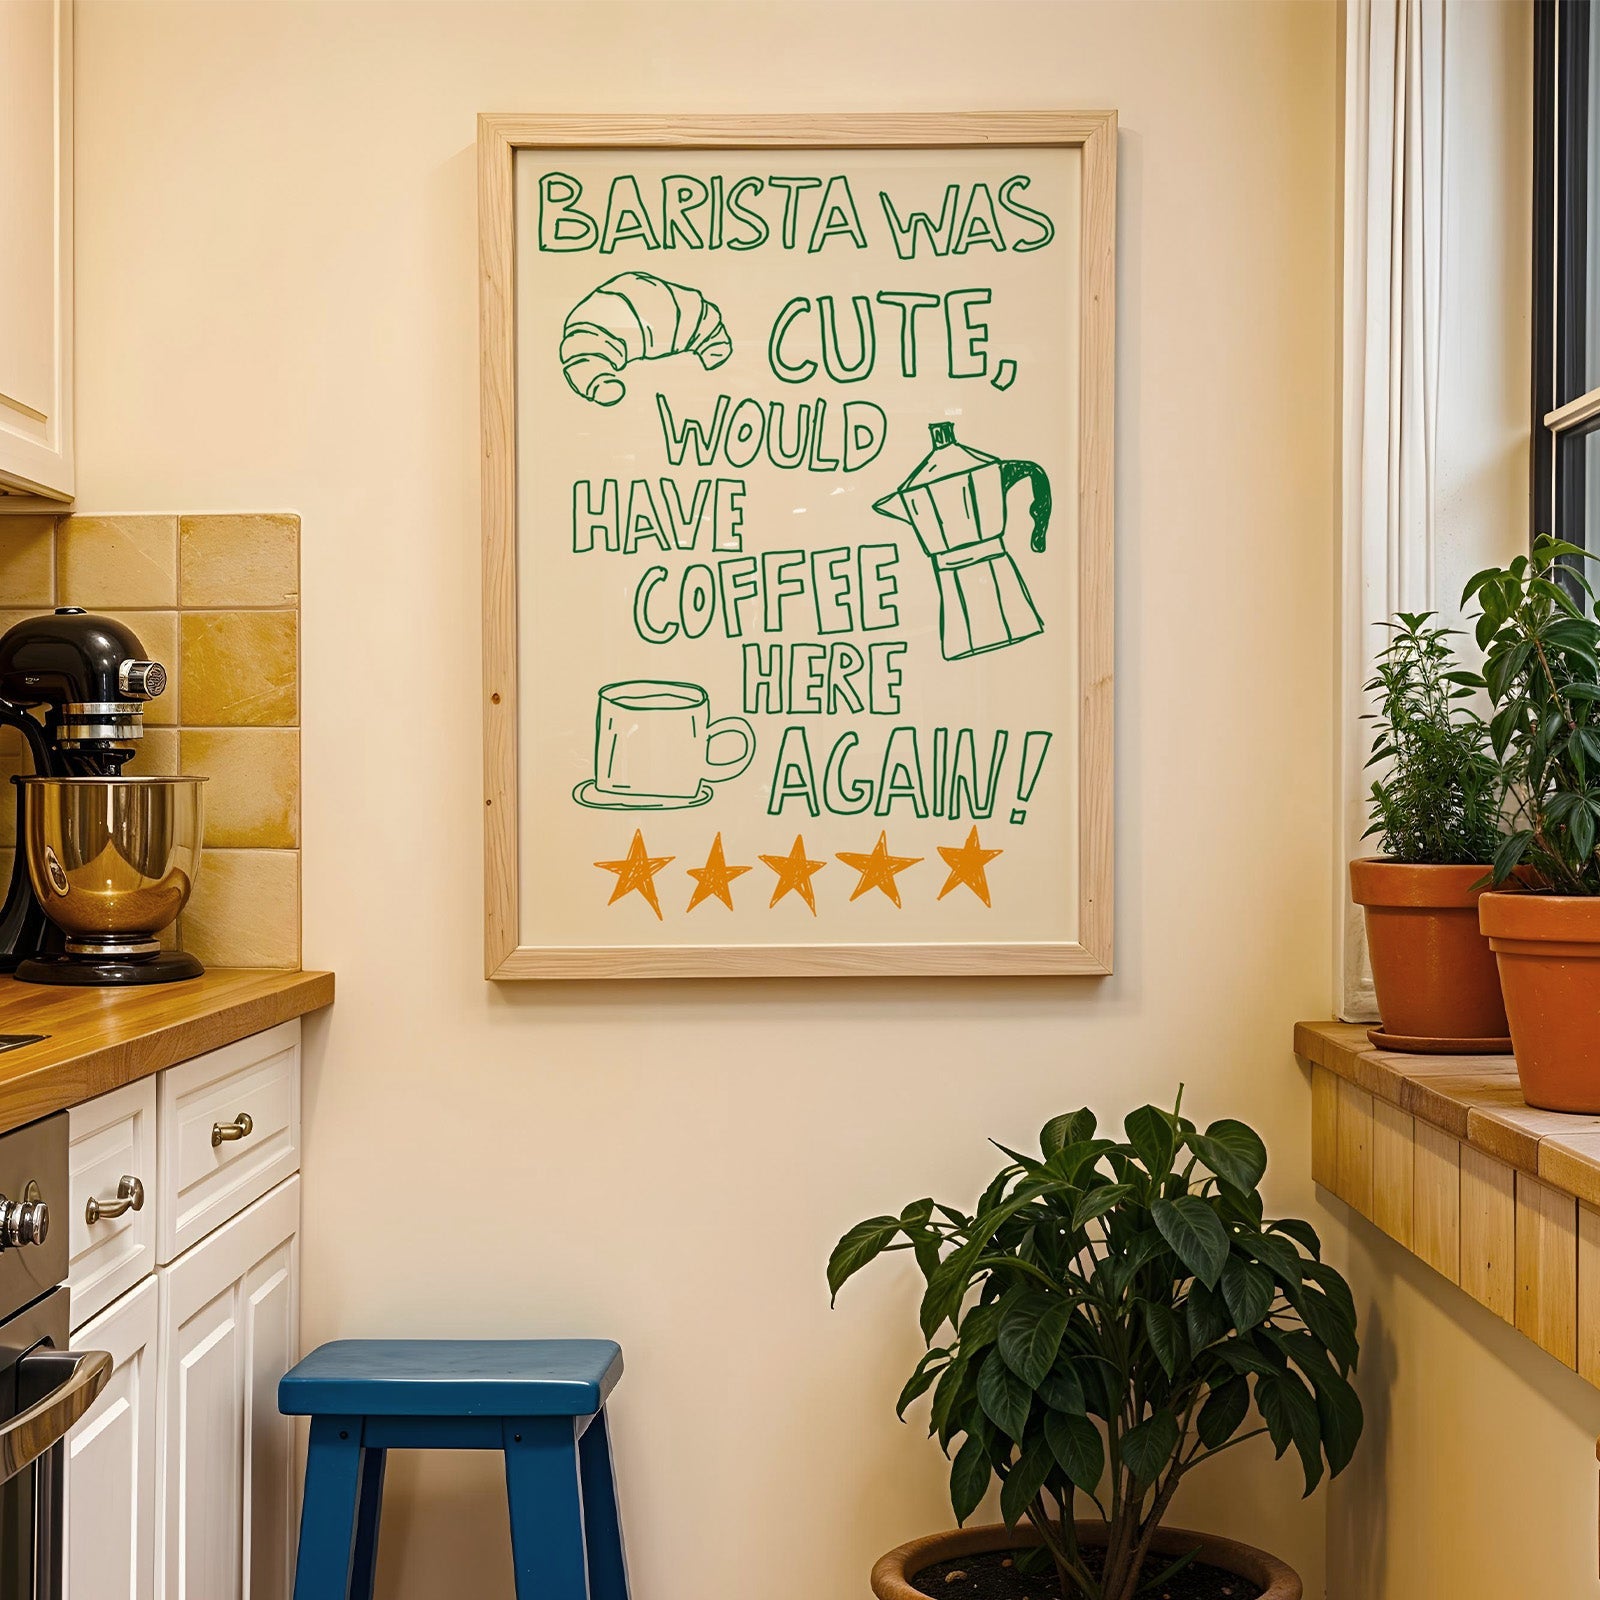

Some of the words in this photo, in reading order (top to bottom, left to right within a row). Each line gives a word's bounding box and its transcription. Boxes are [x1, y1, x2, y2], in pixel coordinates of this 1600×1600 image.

[539, 172, 867, 254] BARISTA
[880, 176, 1054, 260] WAS
[768, 288, 1017, 391] CUTE,
[656, 393, 887, 472] WOULD
[573, 478, 746, 554] HAVE
[634, 543, 899, 644] COFFEE
[742, 642, 907, 715] HERE
[768, 726, 1052, 824] AGAIN!
